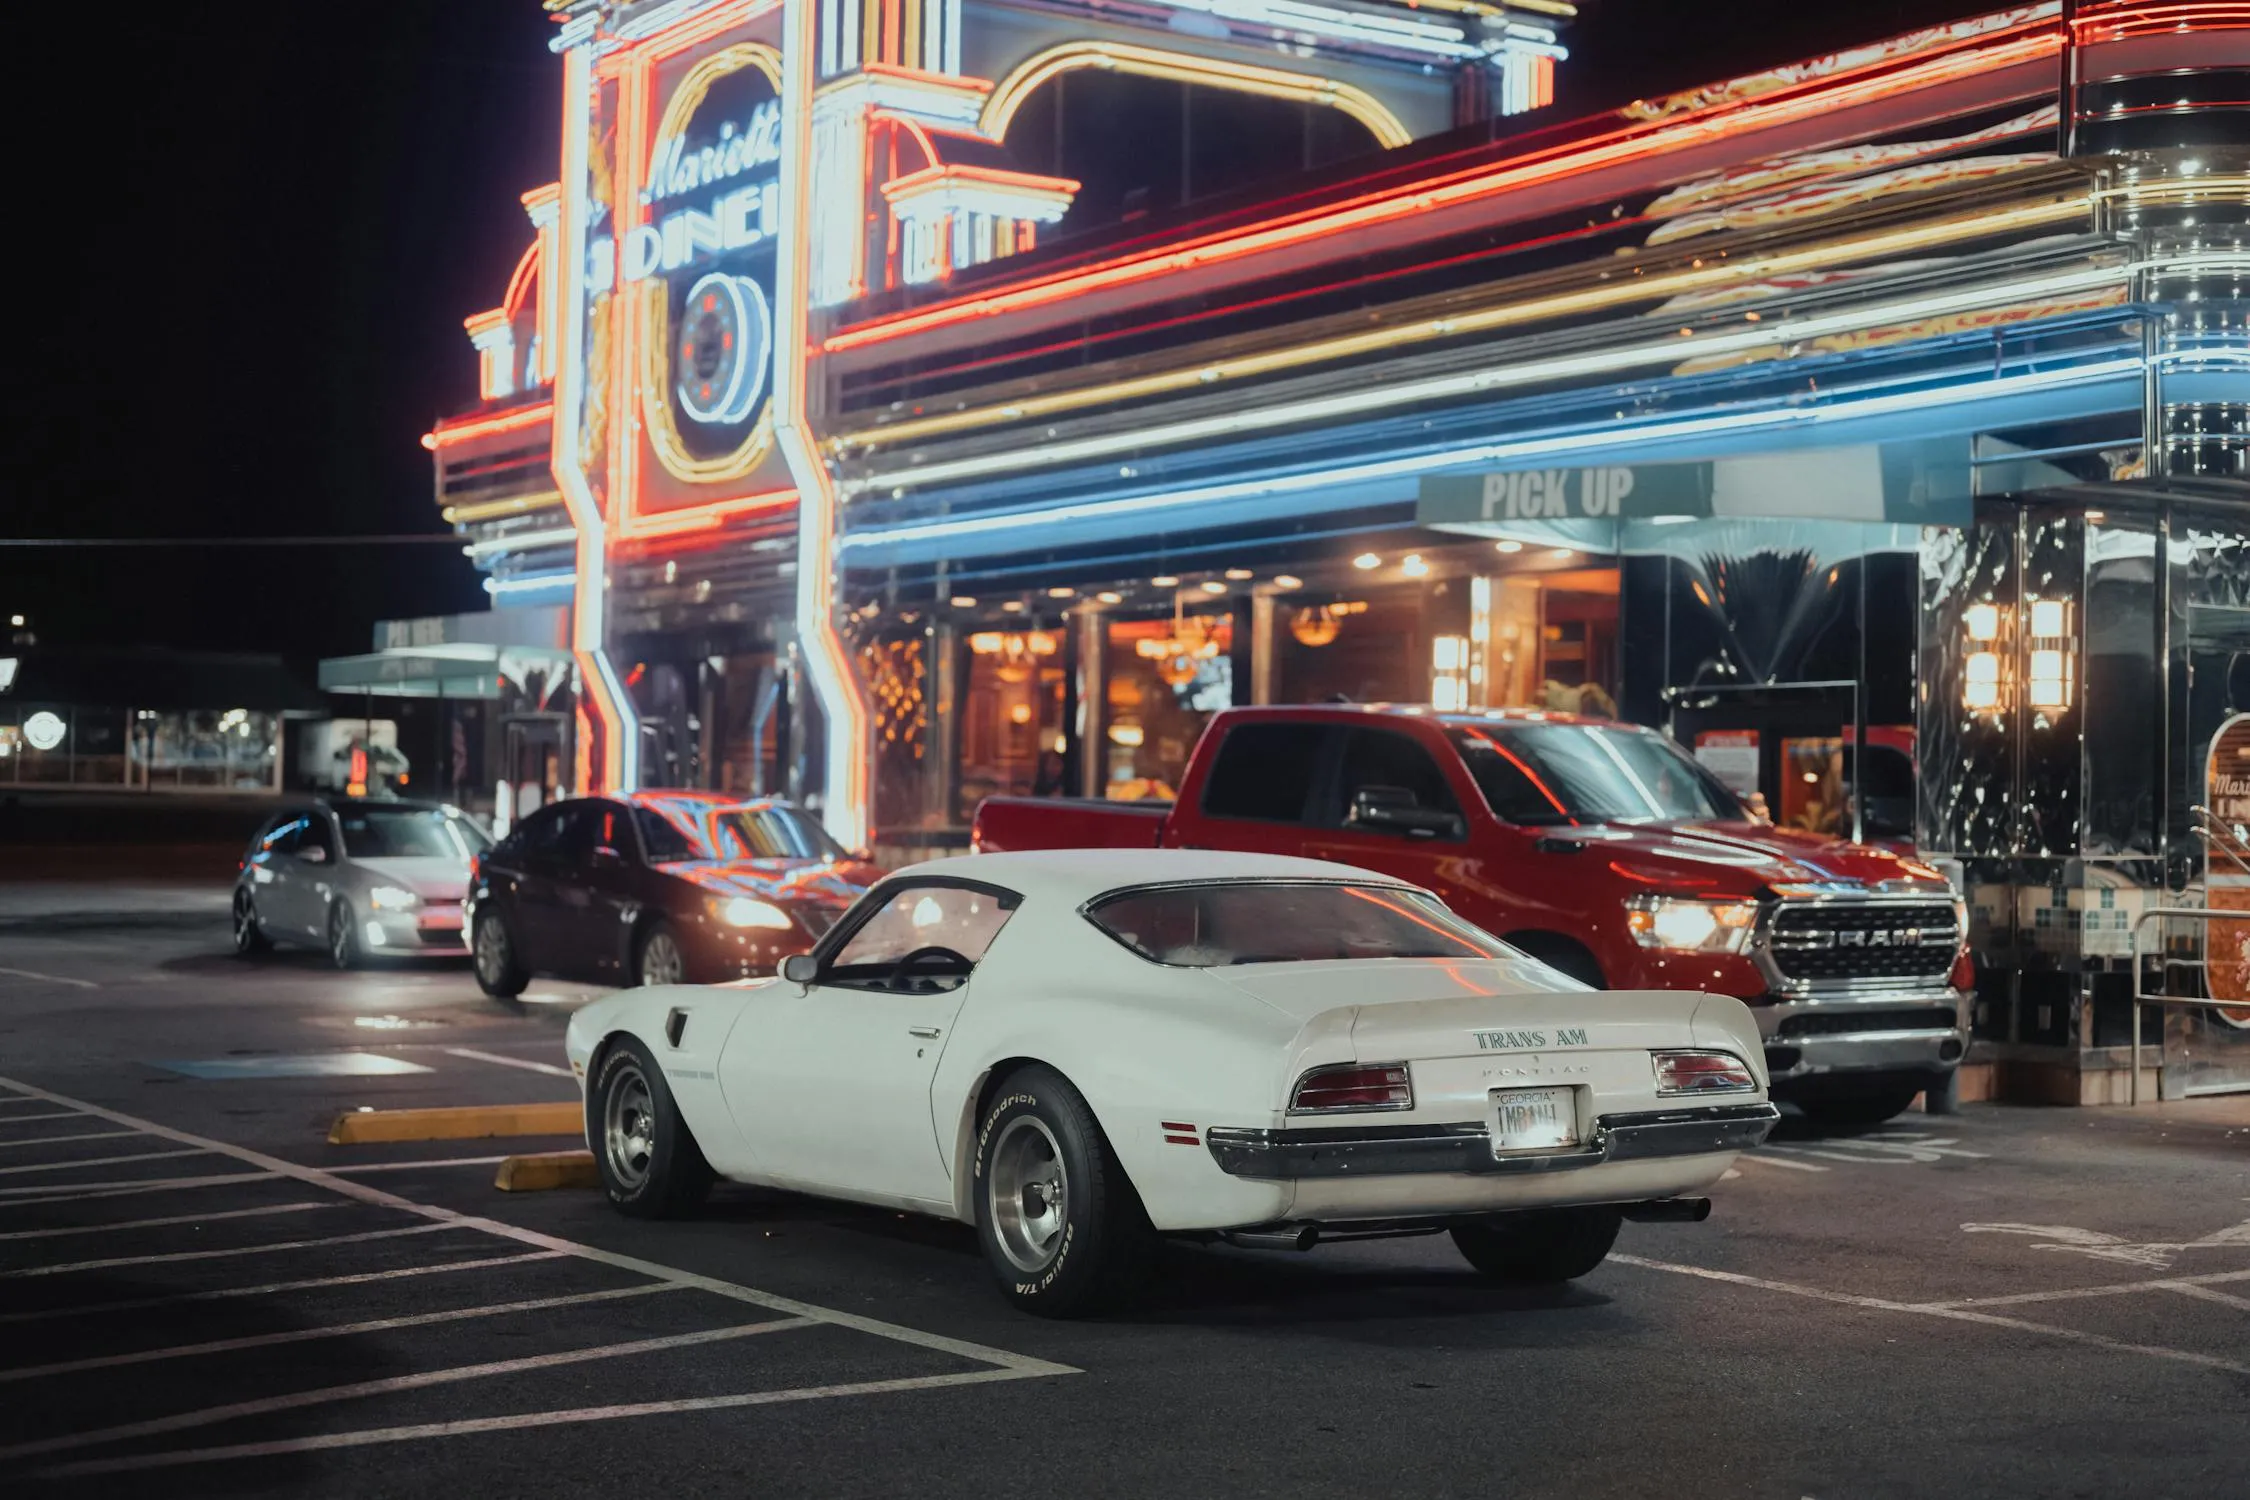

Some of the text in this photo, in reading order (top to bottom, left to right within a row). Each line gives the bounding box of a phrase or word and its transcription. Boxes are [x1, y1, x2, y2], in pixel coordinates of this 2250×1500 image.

[1481, 466, 1635, 519] PICK UP
[1839, 928, 1922, 947] RAM
[1473, 1028, 1588, 1050] TRANS AM
[1481, 1065, 1591, 1078] PONTIAC
[1500, 1092, 1551, 1105] GEORGIA
[974, 1092, 1037, 1179] BFGoodrich
